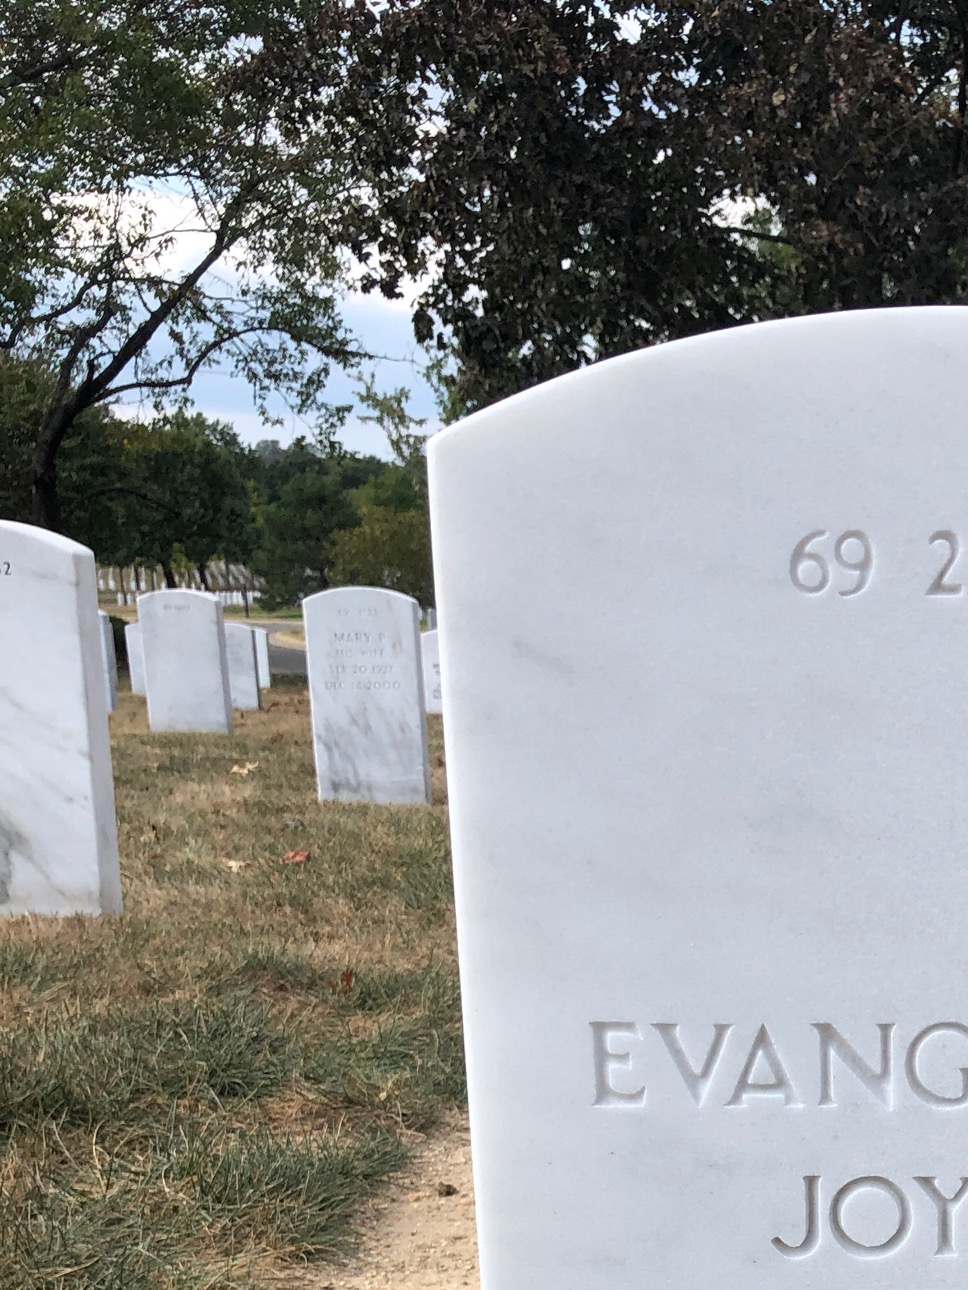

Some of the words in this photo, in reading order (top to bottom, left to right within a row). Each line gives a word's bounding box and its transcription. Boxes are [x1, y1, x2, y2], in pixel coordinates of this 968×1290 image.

[788, 529, 873, 598] 69
[333, 632, 371, 643] MARY
[353, 664, 368, 675] 20
